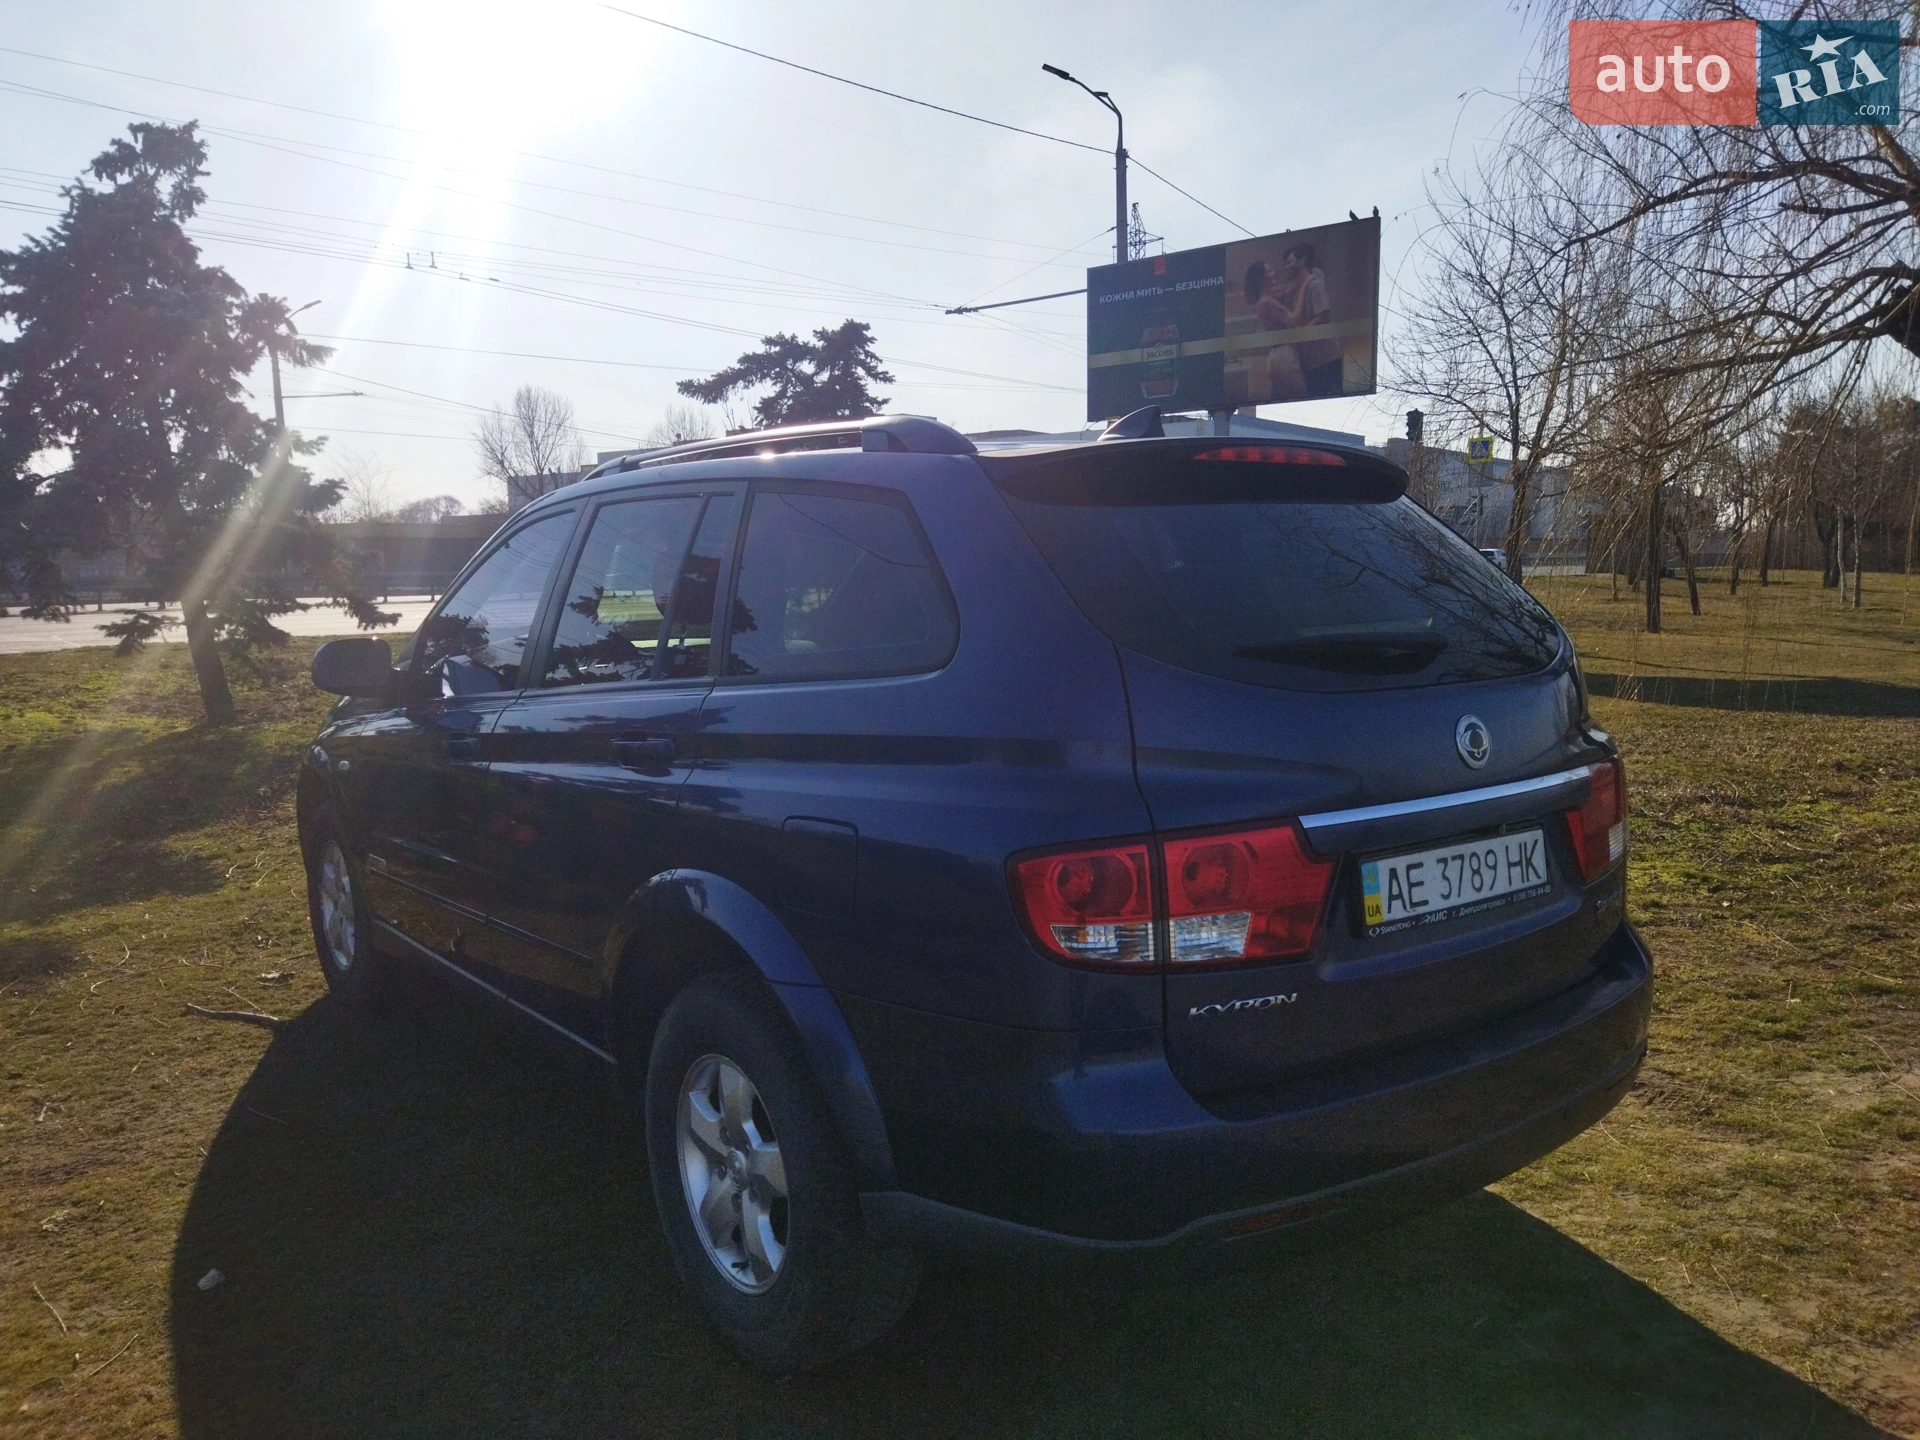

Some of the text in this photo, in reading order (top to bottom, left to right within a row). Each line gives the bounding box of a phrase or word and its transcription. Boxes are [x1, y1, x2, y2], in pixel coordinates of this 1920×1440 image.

[1099, 275, 1225, 304] КОЖНА МИТЬ БЕЗЦІННА
[1146, 348, 1174, 359] JACOBS
[1387, 838, 1542, 914] AE 3789 HK
[1367, 903, 1382, 918] UA
[1187, 992, 1298, 1020] KYRON
